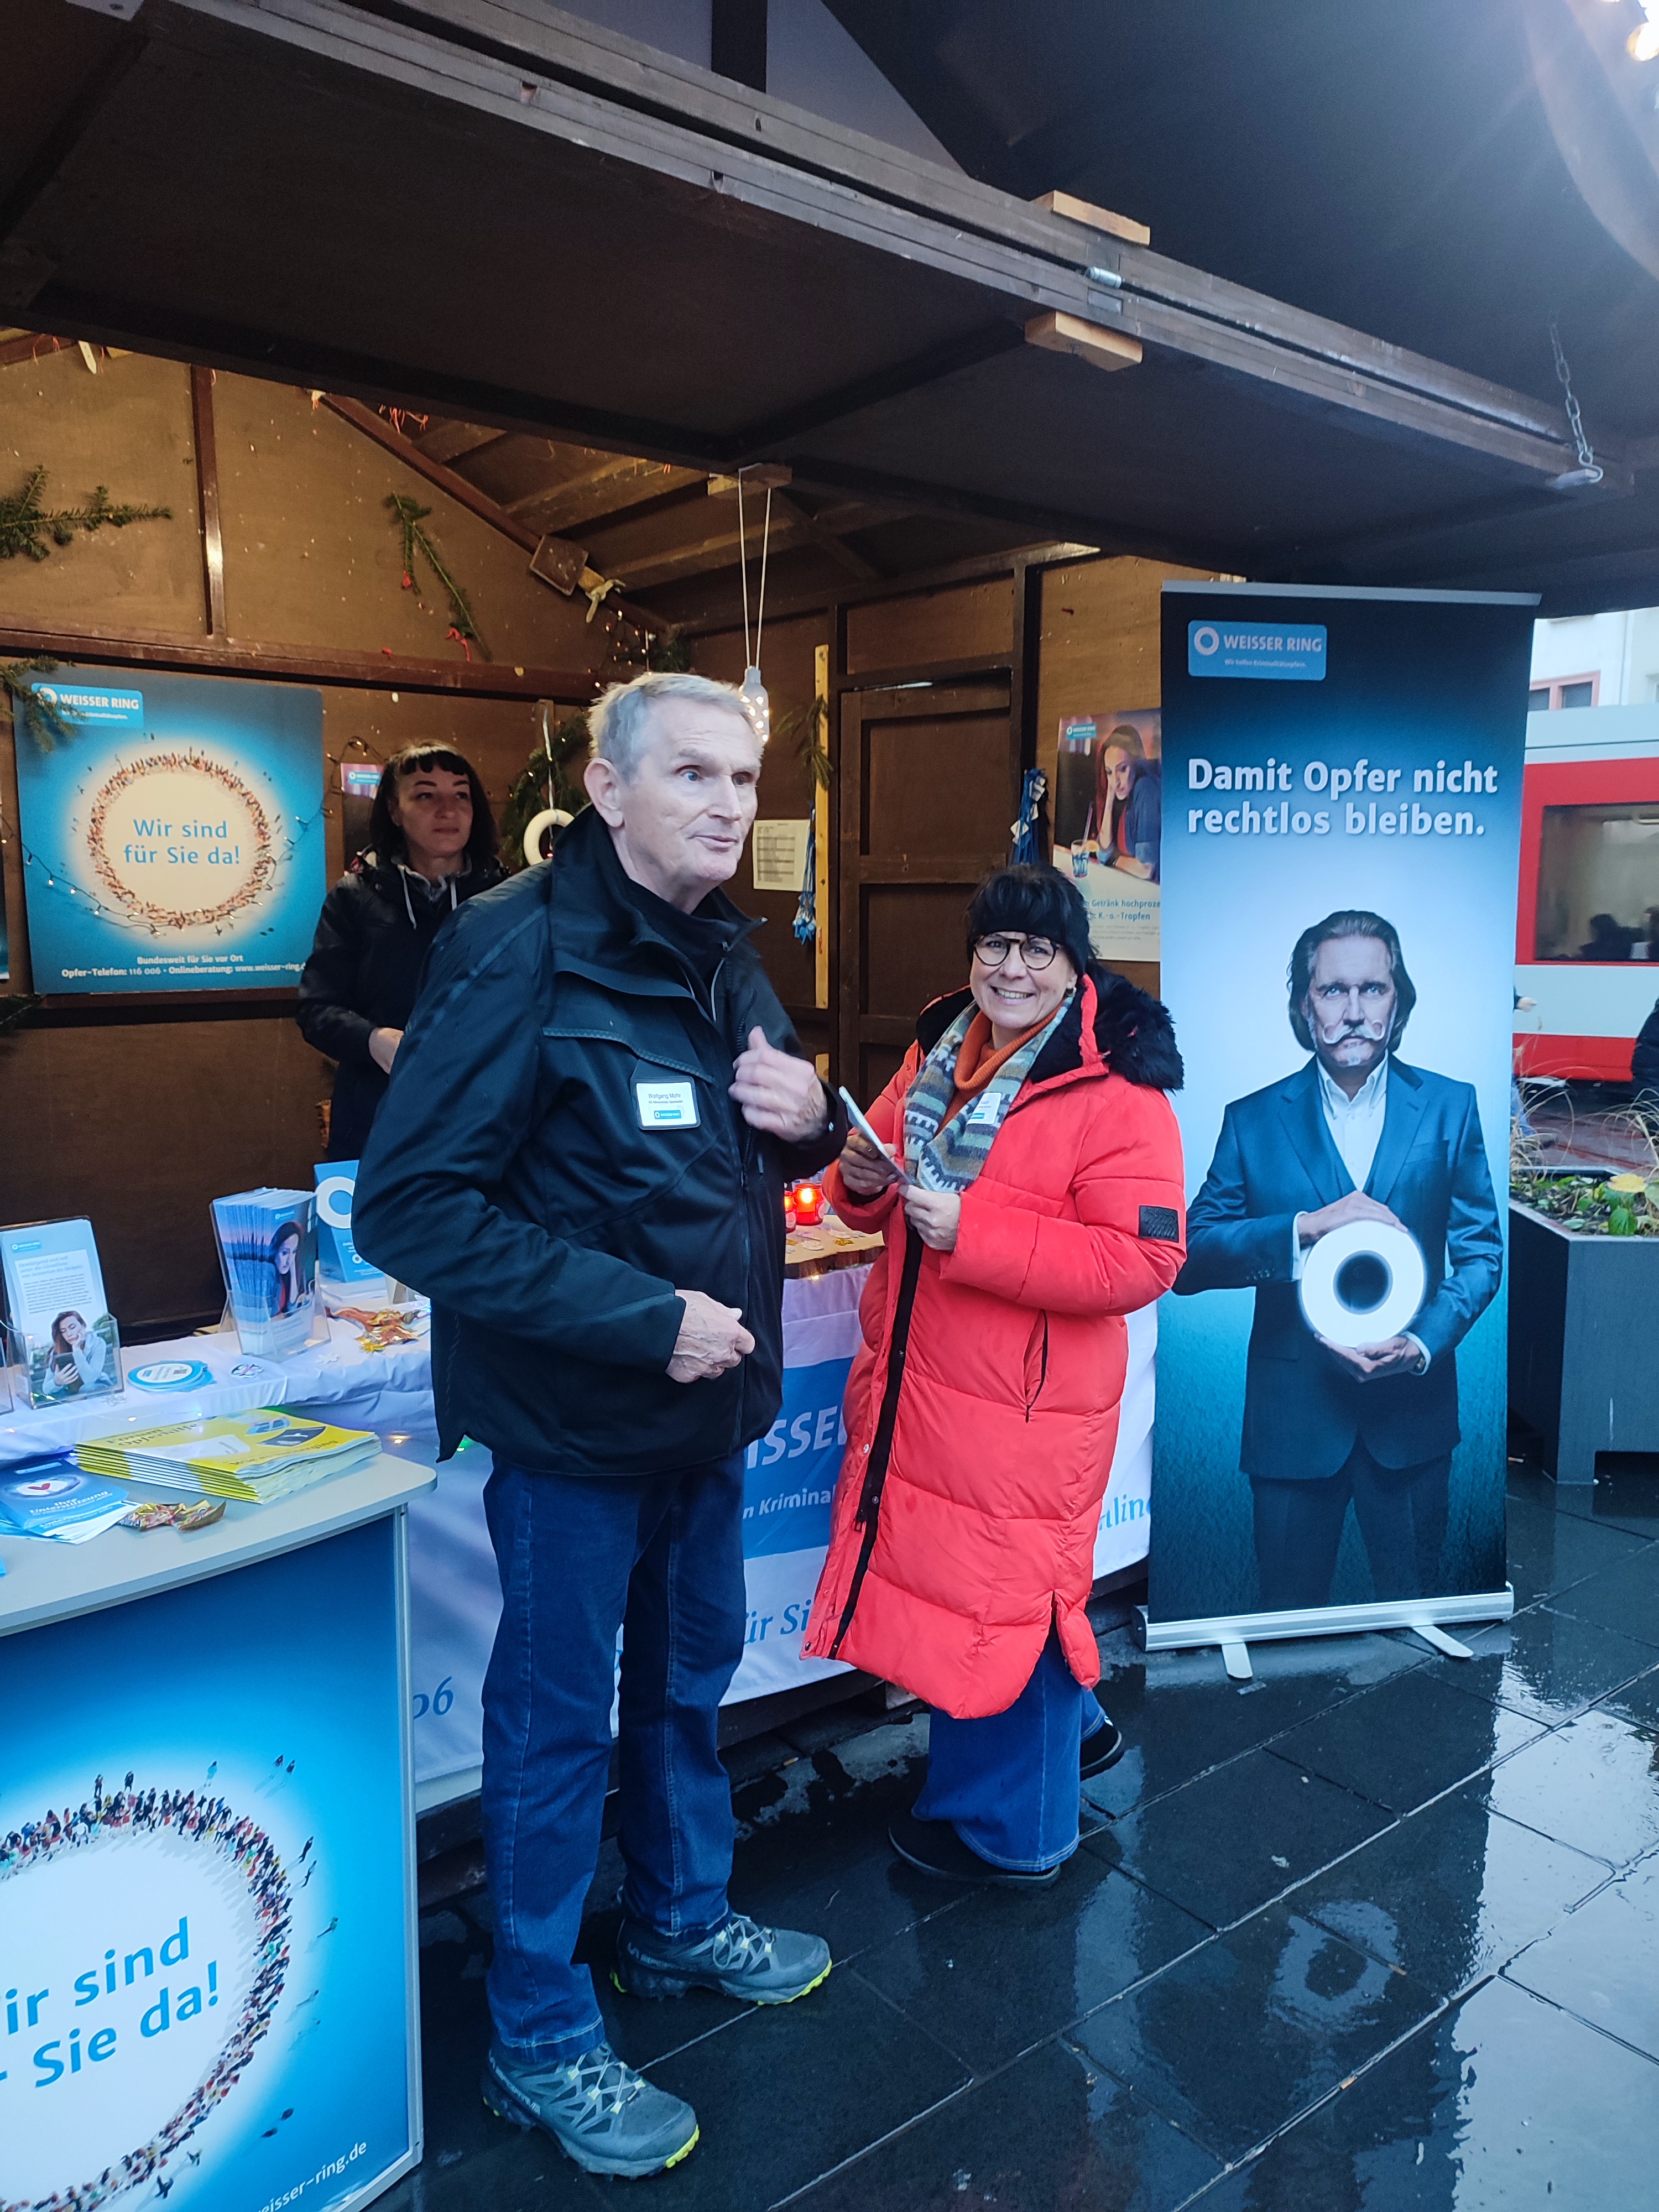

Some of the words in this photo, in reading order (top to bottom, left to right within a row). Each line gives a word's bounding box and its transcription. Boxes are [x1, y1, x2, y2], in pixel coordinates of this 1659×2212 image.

[1224, 635, 1283, 650] WEISSER
[1287, 637, 1322, 652] RING
[60, 693, 109, 707] WEISSER
[111, 697, 139, 709] RING
[1188, 758, 1292, 791] Damit
[1303, 759, 1401, 801] Opfer
[1413, 760, 1498, 793] nicht
[133, 818, 173, 836] Wir
[182, 820, 227, 838] sind
[1188, 801, 1330, 834] rechtlos
[1345, 802, 1485, 836] bleiben.
[124, 844, 158, 863] für
[167, 846, 199, 864] Sie
[207, 845, 240, 864] da!
[1092, 899, 1119, 907] Getränk
[137, 956, 185, 964] Bundesweit
[187, 955, 199, 963] für
[201, 954, 213, 963] Sie
[230, 954, 243, 962] Ort
[61, 968, 127, 978] Opfer-Telefon:
[2, 1988, 49, 2036] ir
[74, 1916, 189, 2007] sind
[33, 2028, 117, 2088] Sie
[140, 1960, 218, 2038] da!
